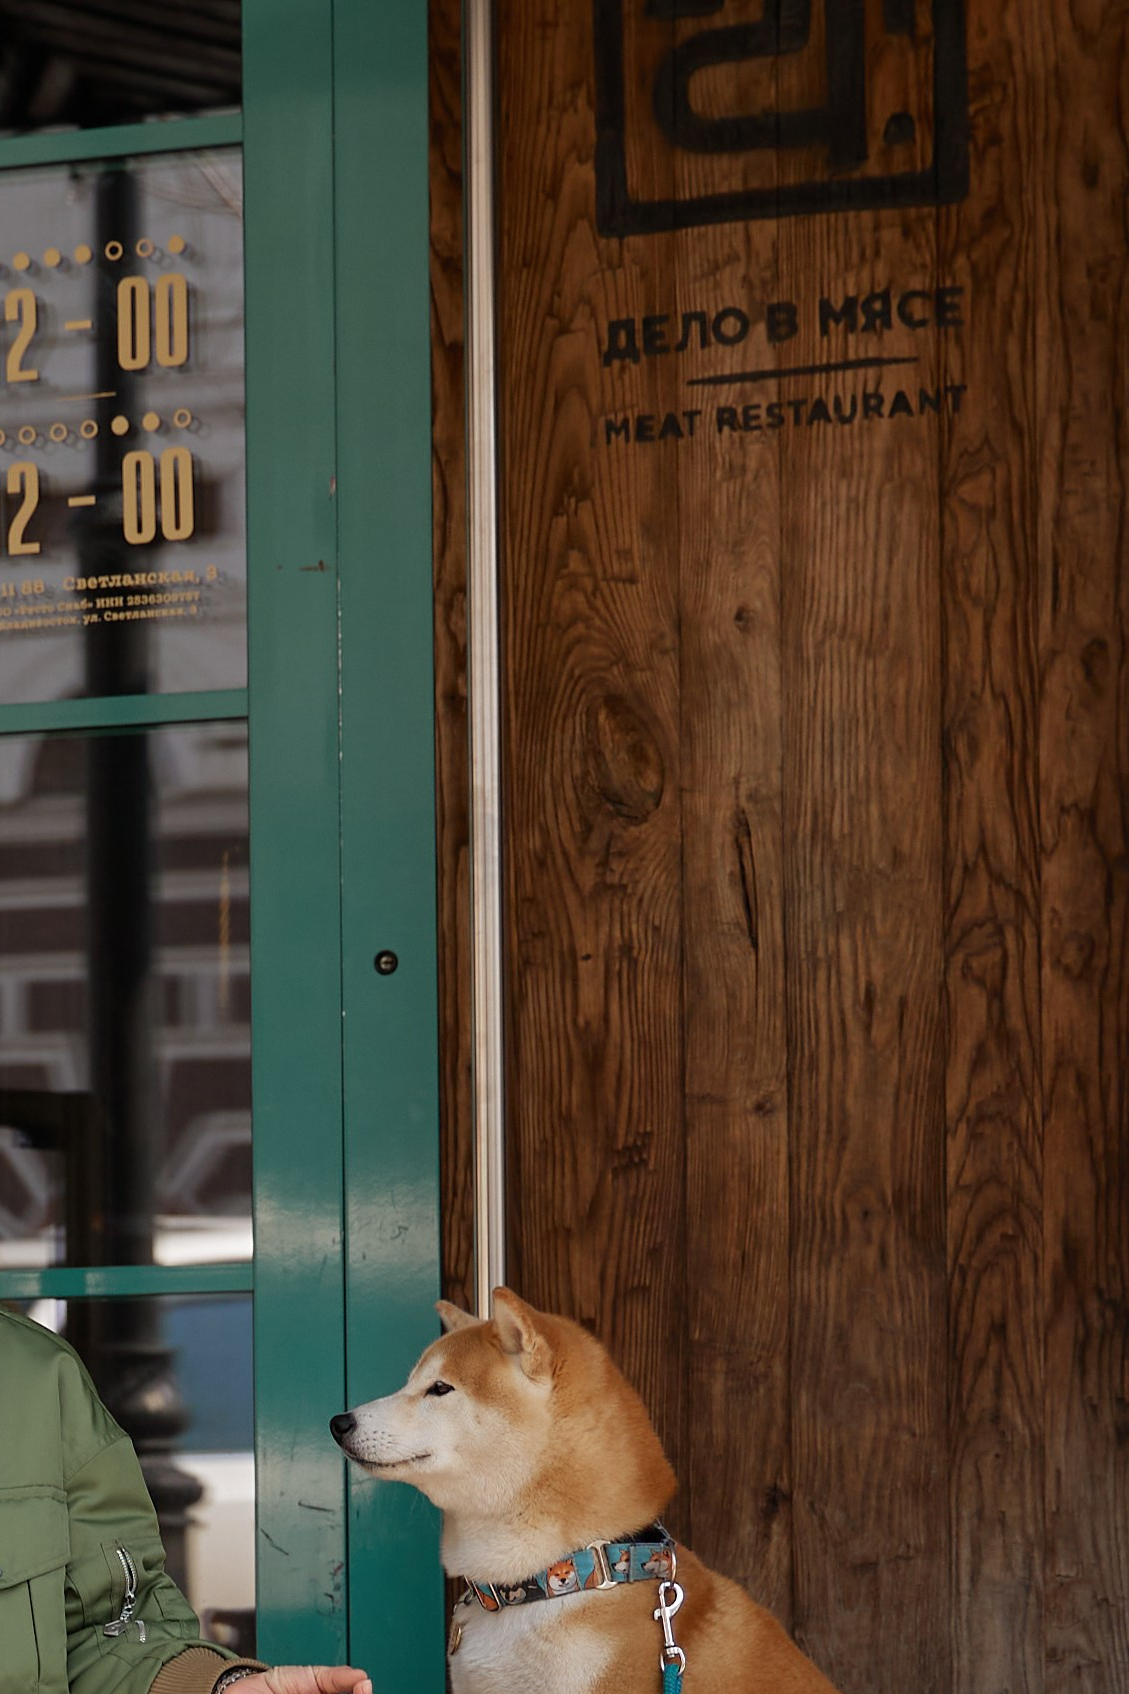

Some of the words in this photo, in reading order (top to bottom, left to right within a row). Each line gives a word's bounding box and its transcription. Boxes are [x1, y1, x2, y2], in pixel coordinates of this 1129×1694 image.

[116, 273, 189, 372] 00
[602, 307, 751, 368] ДЕЛО
[766, 302, 799, 344] В
[818, 285, 965, 338] МЯСЕ
[604, 409, 703, 447] MEAT
[715, 383, 968, 435] RESTAURANT
[121, 446, 195, 546] 00
[82, 613, 102, 626] ул.
[95, 595, 124, 609] ИНН
